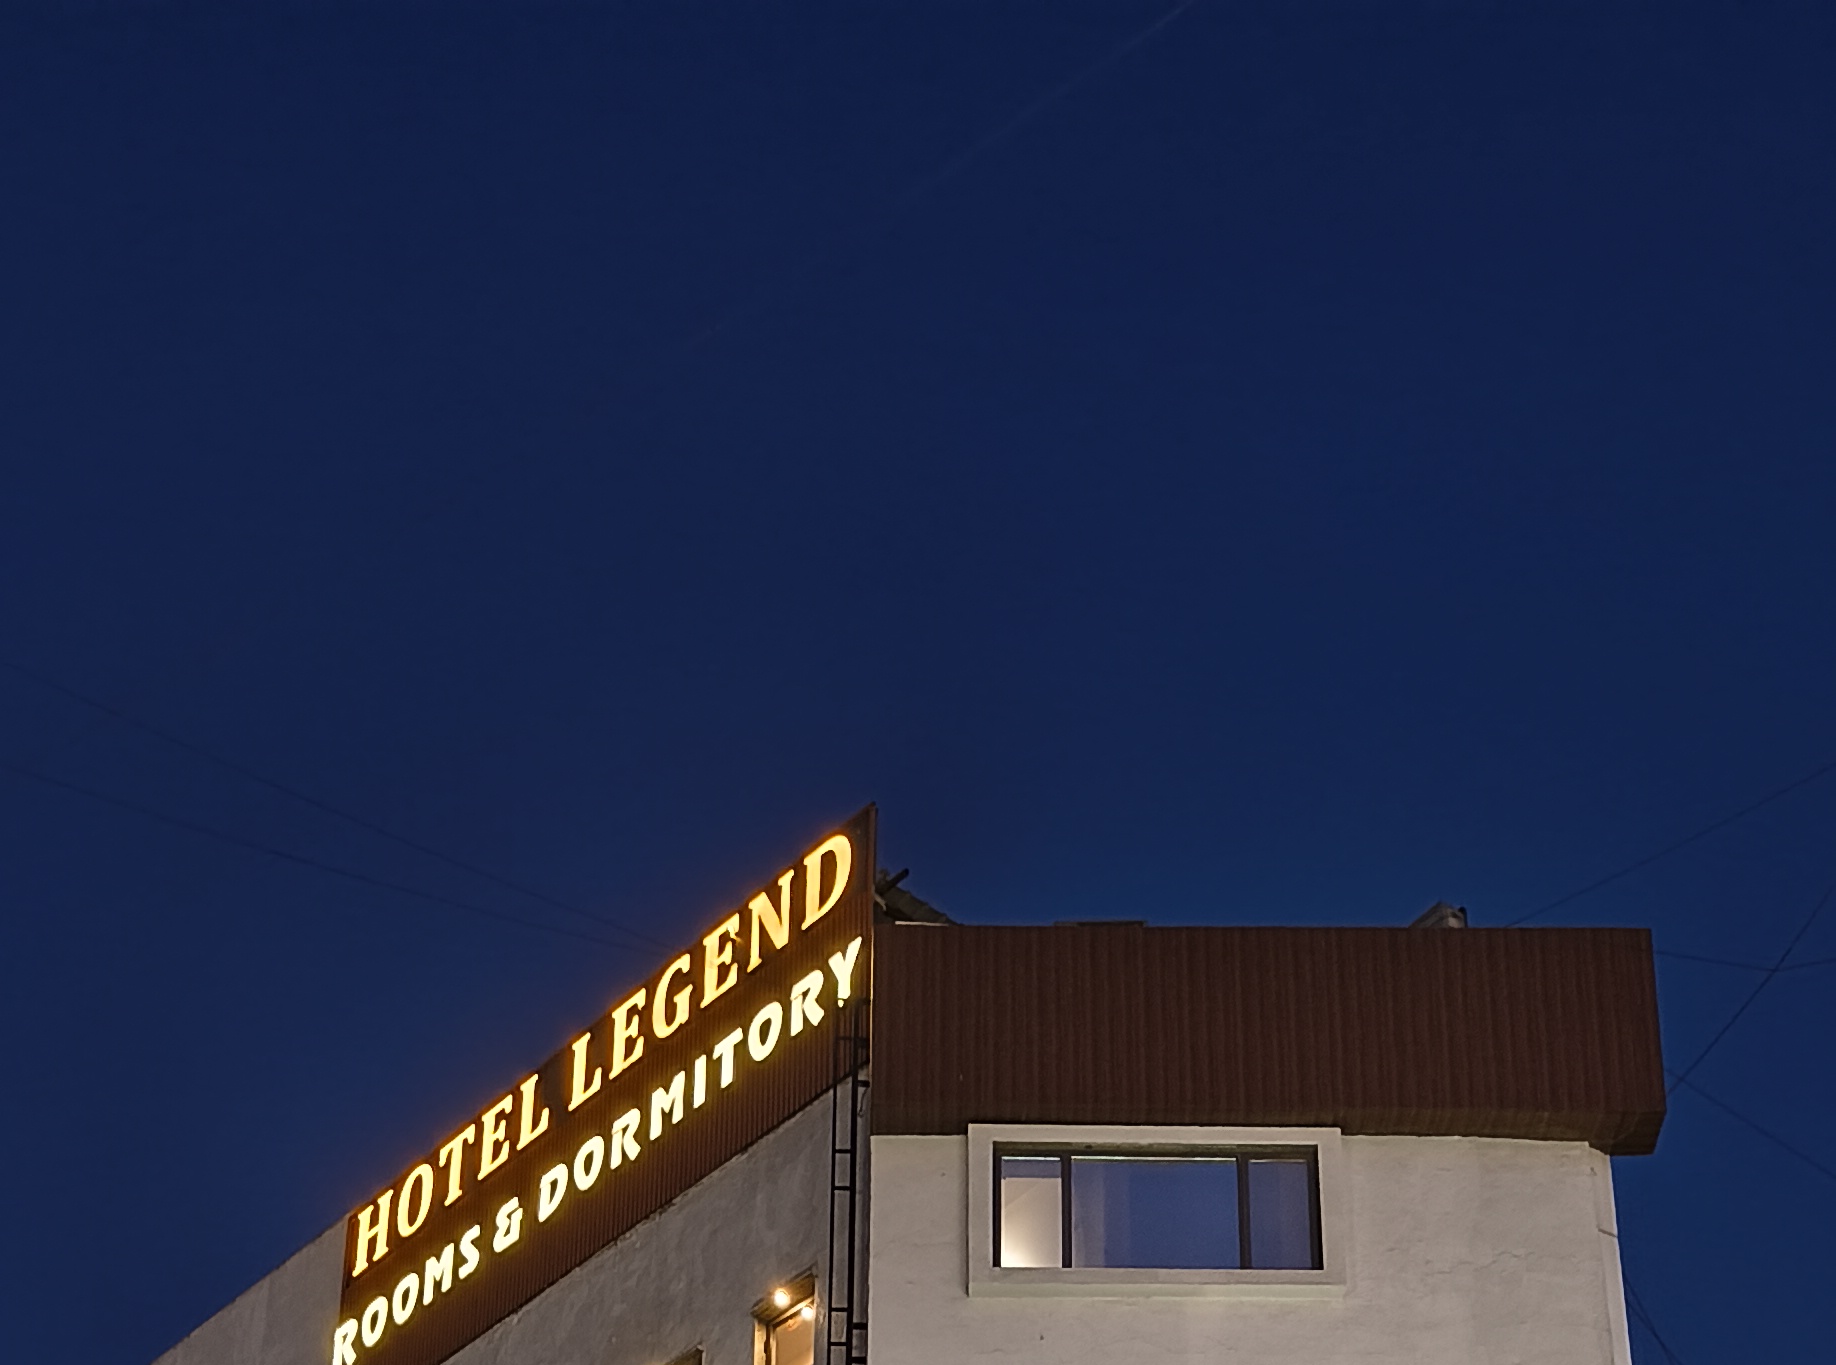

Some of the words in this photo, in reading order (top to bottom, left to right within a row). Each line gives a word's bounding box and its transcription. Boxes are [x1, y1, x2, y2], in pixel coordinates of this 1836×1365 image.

[351, 1073, 550, 1279] HOTEL
[568, 833, 853, 1113] LEGEND
[492, 1197, 524, 1253] &
[538, 936, 863, 1224] DORMITORY
